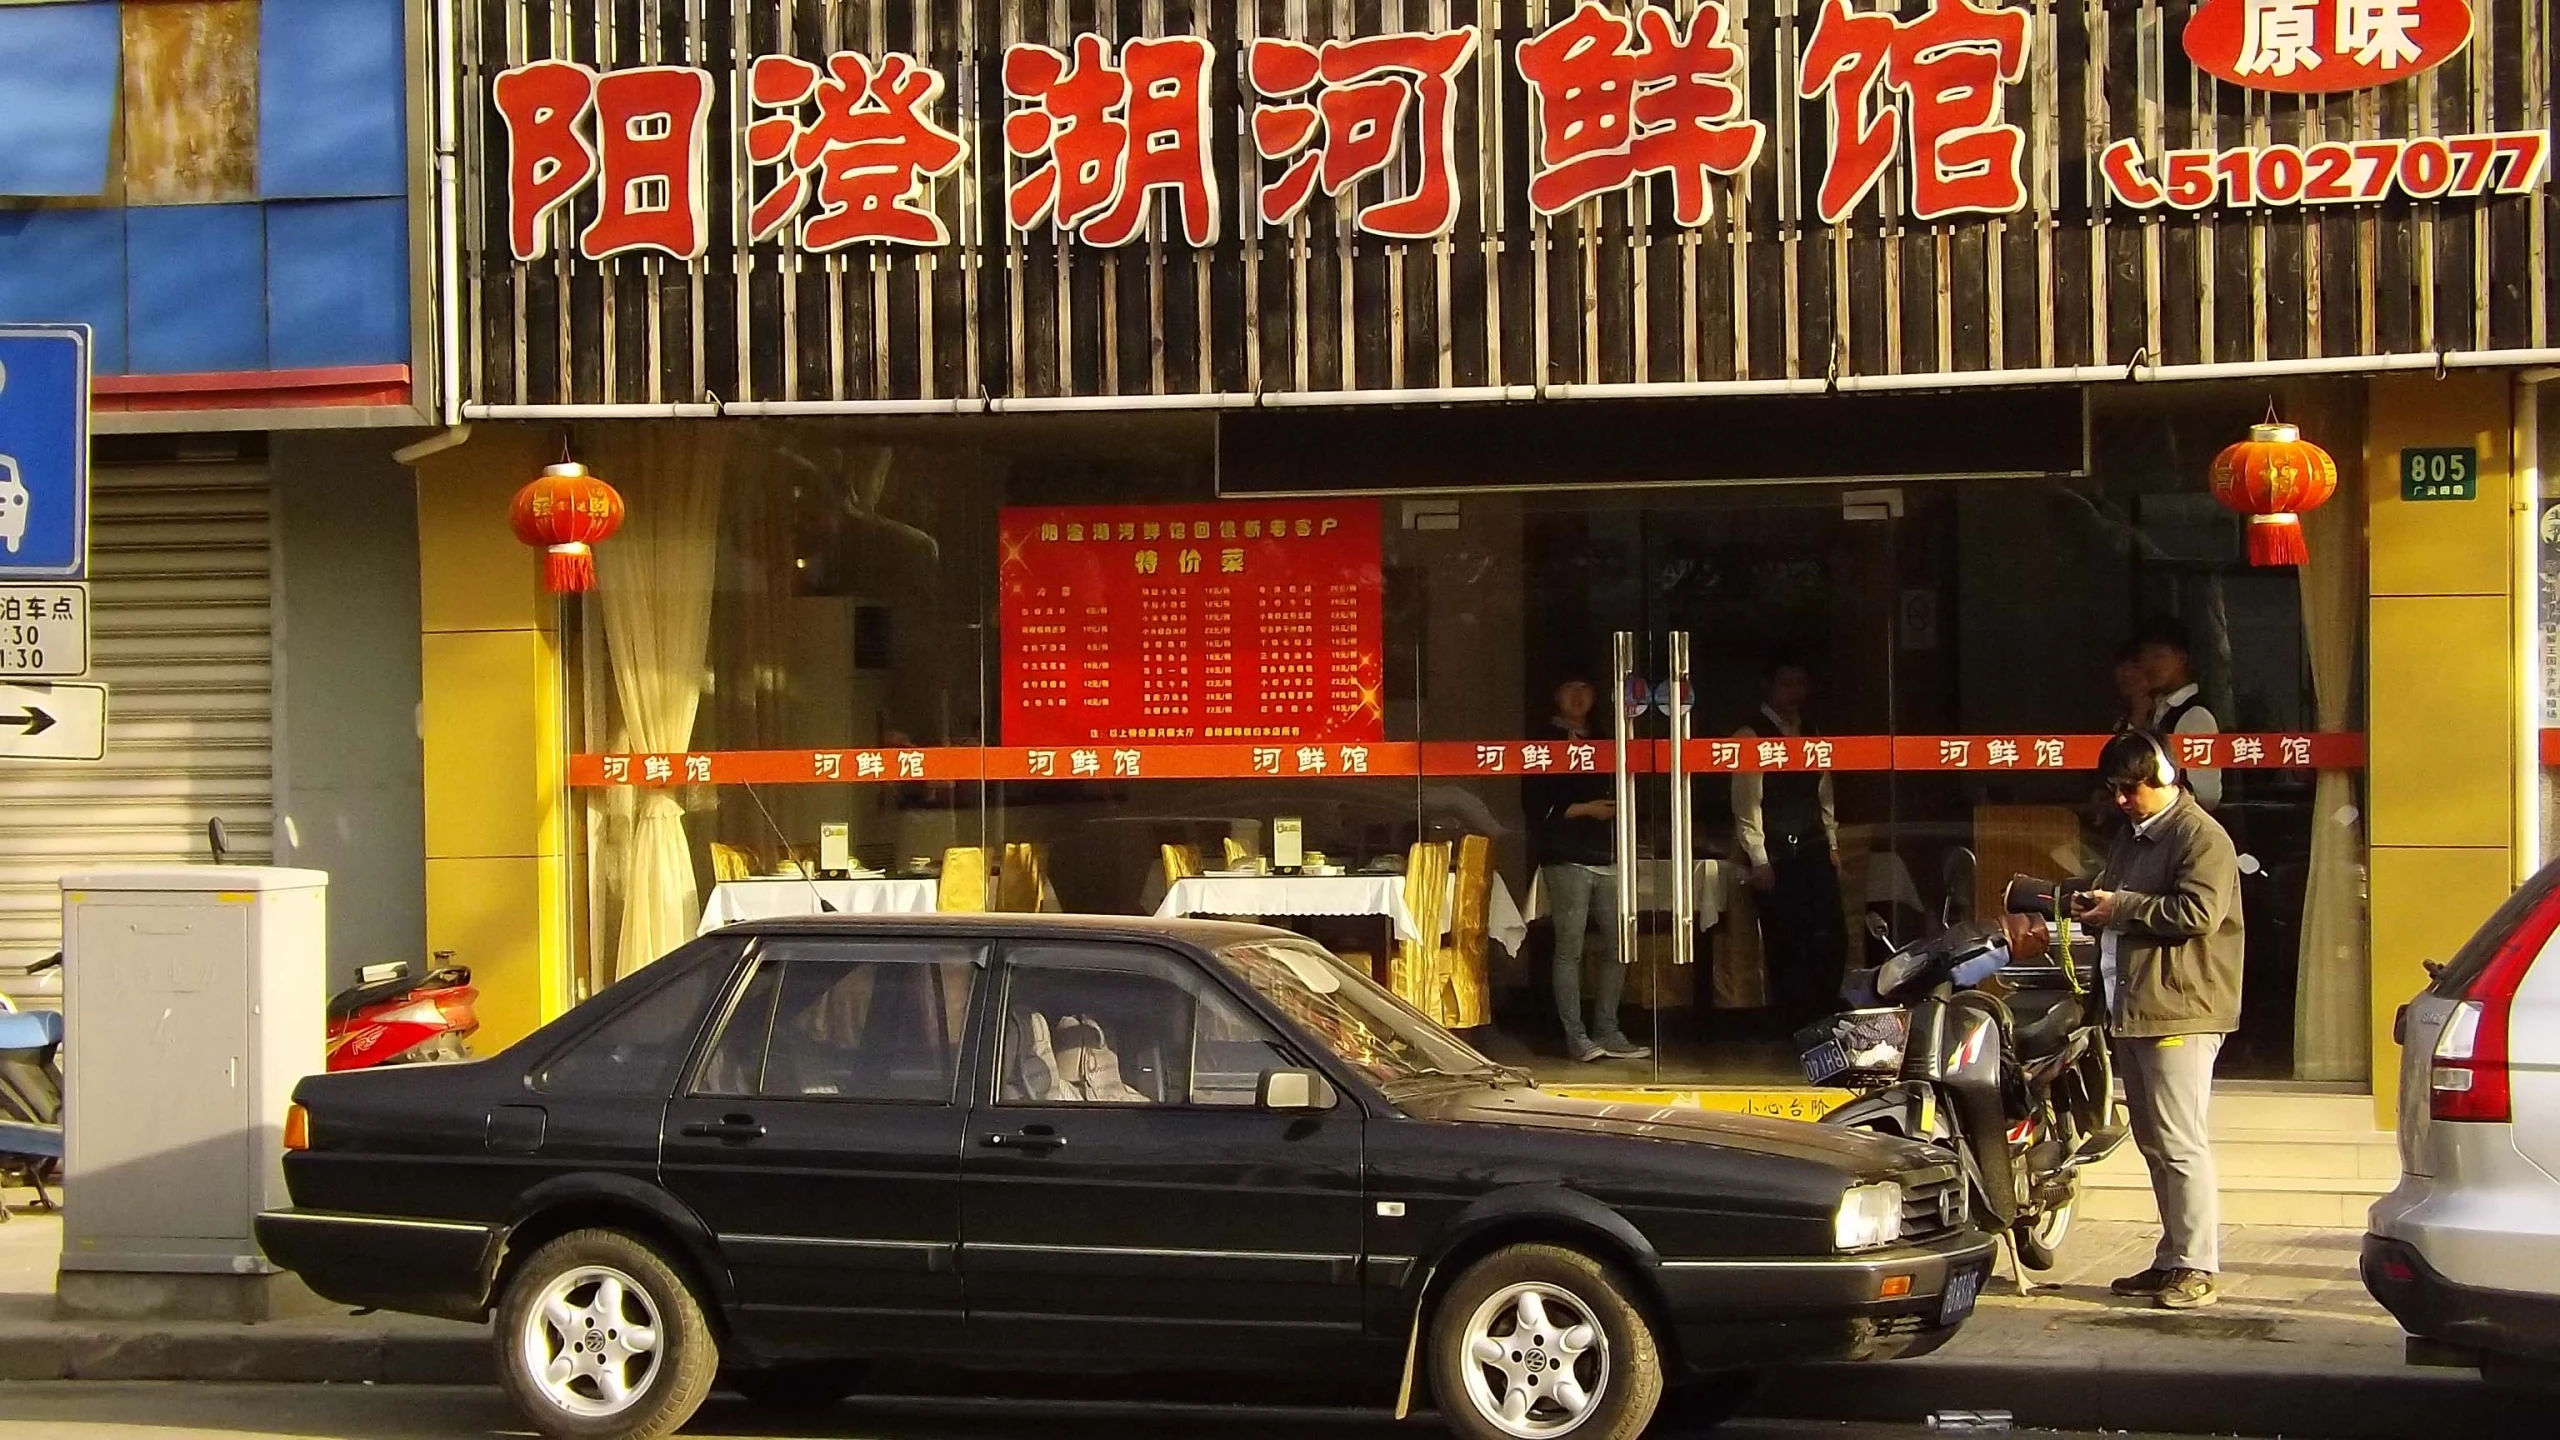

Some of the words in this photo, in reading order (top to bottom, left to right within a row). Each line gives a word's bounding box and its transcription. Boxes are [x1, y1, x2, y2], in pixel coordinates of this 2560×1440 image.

[2232, 0, 2424, 79] 原味
[493, 0, 2034, 262] 阳澄湖河鲜馆
[2163, 130, 2551, 210] 51027077
[2411, 454, 2466, 482] 805
[1133, 547, 1246, 575] 特价菜
[0, 595, 74, 621] 泊车点
[814, 750, 925, 779] 河鲜馆
[1028, 748, 1141, 778] 河鲜馆
[1253, 745, 1368, 775] 河鲜馆
[1476, 743, 1596, 772] 河鲜馆
[1711, 740, 1833, 769] 河鲜馆
[1940, 738, 2065, 768] 河鲜馆
[2183, 736, 2312, 766] 河鲜馆
[603, 755, 712, 782] 河鲜馆
[1740, 1097, 1831, 1118] 小心台阶
